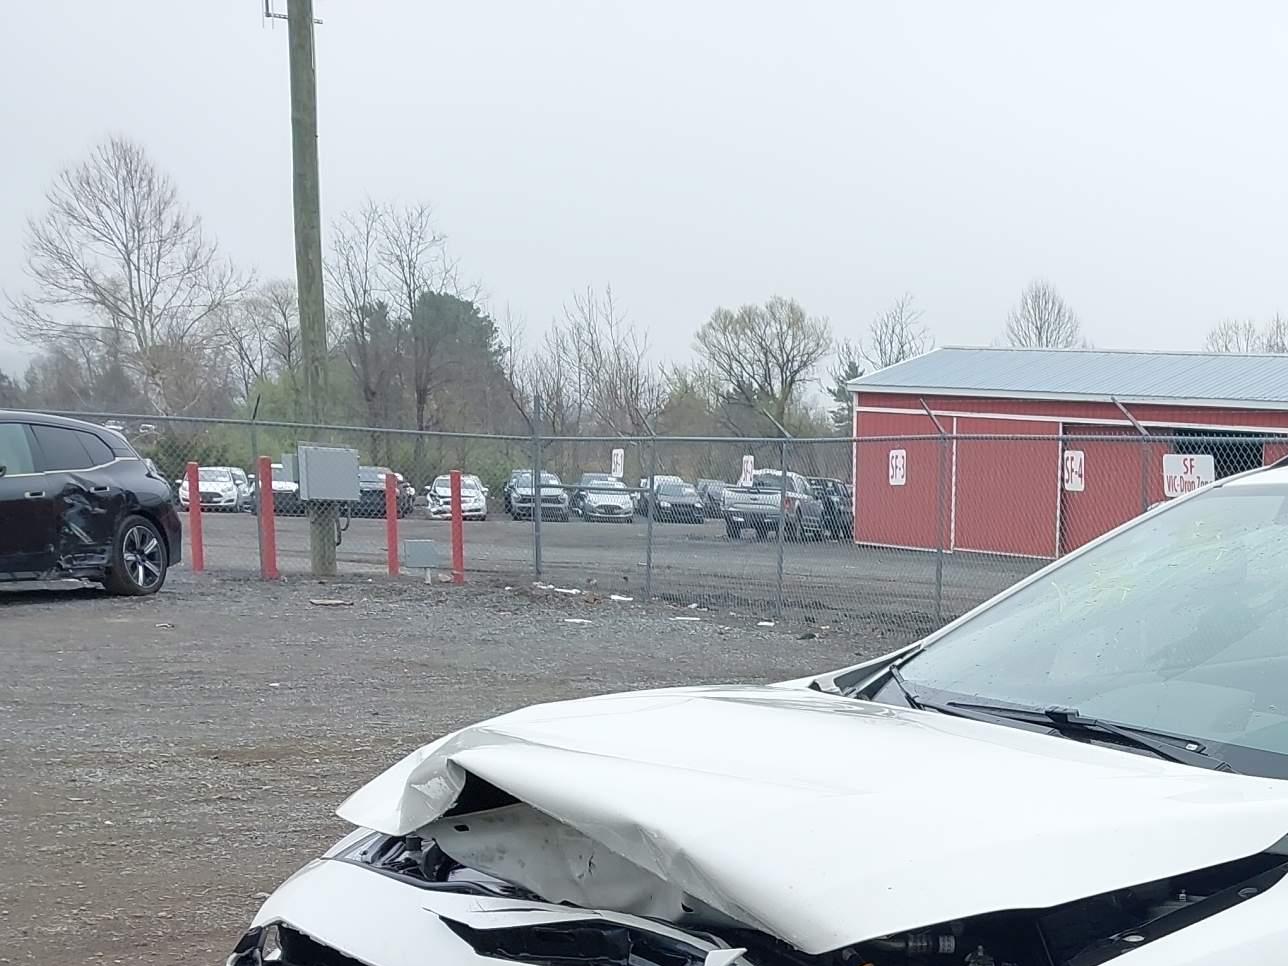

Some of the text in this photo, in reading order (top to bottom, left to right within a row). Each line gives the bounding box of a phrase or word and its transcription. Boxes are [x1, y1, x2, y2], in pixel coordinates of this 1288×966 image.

[890, 454, 905, 479] SF-3
[1065, 455, 1083, 485] SF-4
[1182, 457, 1195, 475] SF
